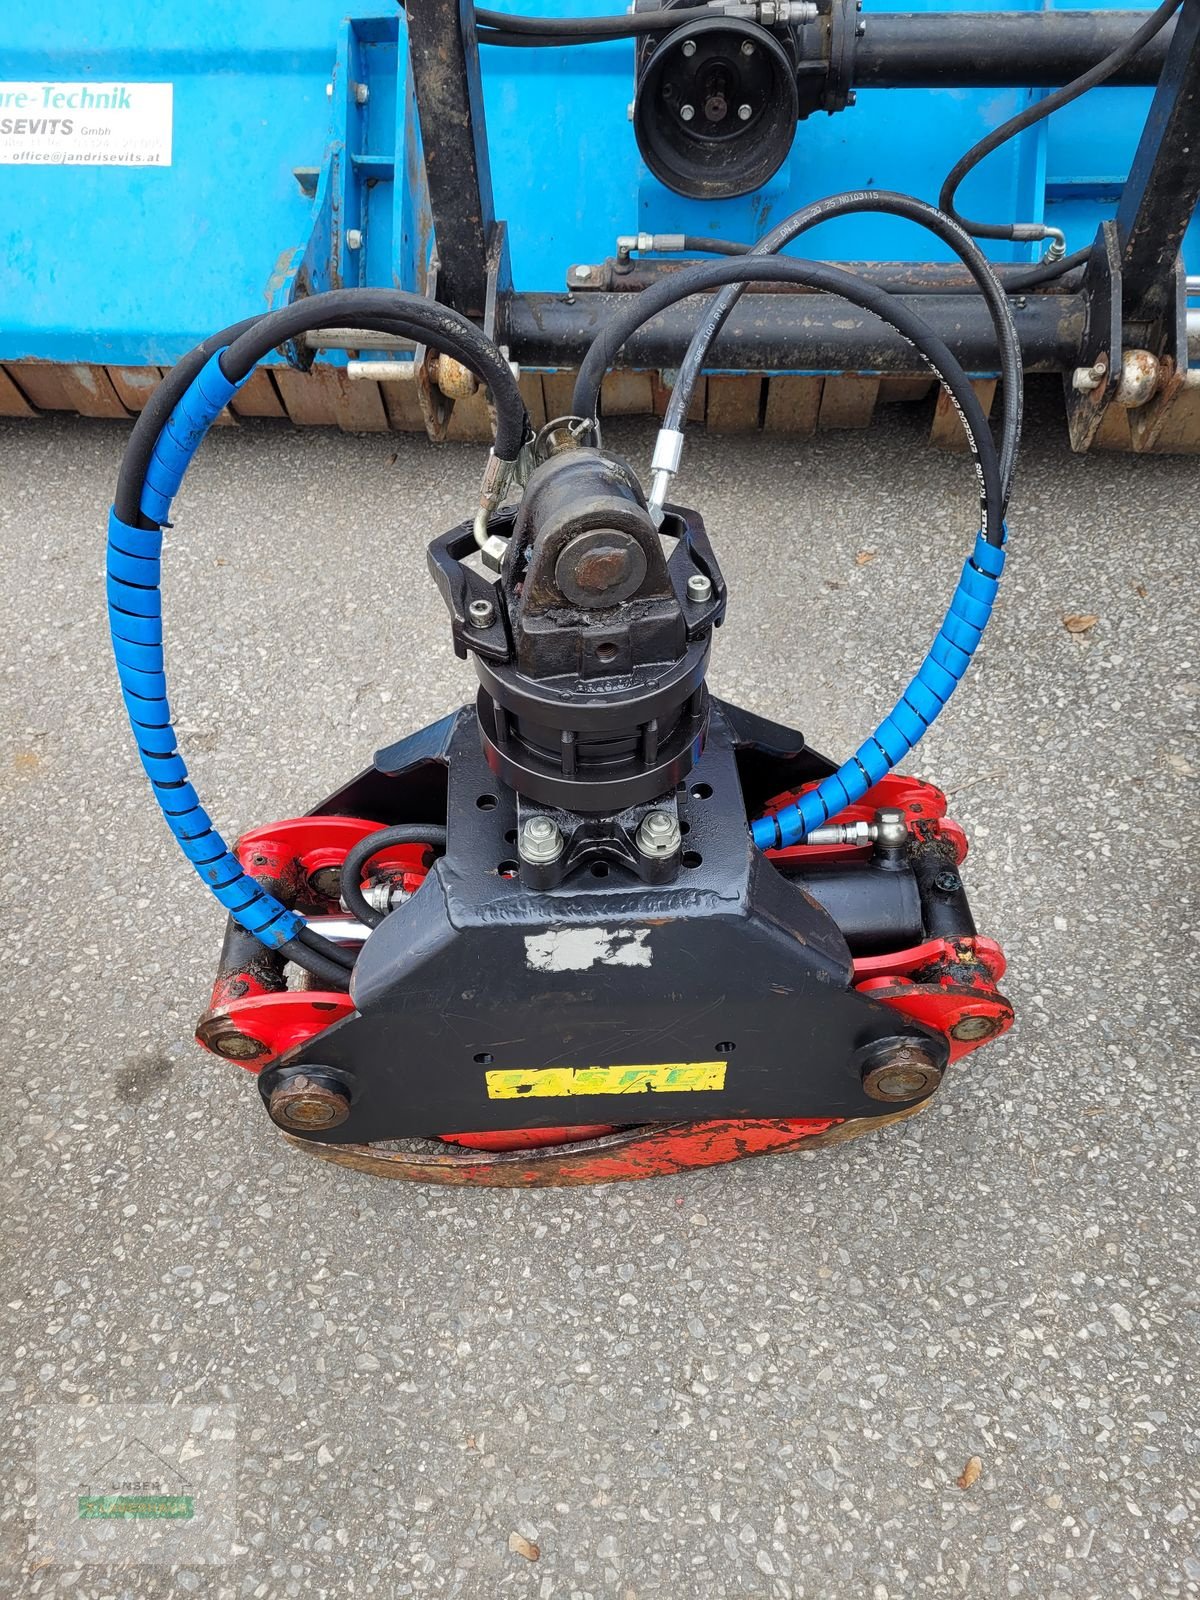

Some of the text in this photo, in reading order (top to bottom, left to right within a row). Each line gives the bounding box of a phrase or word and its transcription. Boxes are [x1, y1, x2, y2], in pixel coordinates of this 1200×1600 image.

[80, 126, 111, 136] Gmbh
[12, 150, 160, 164] office@jandrisevits.at
[958, 410, 978, 453] EXCEEDS
